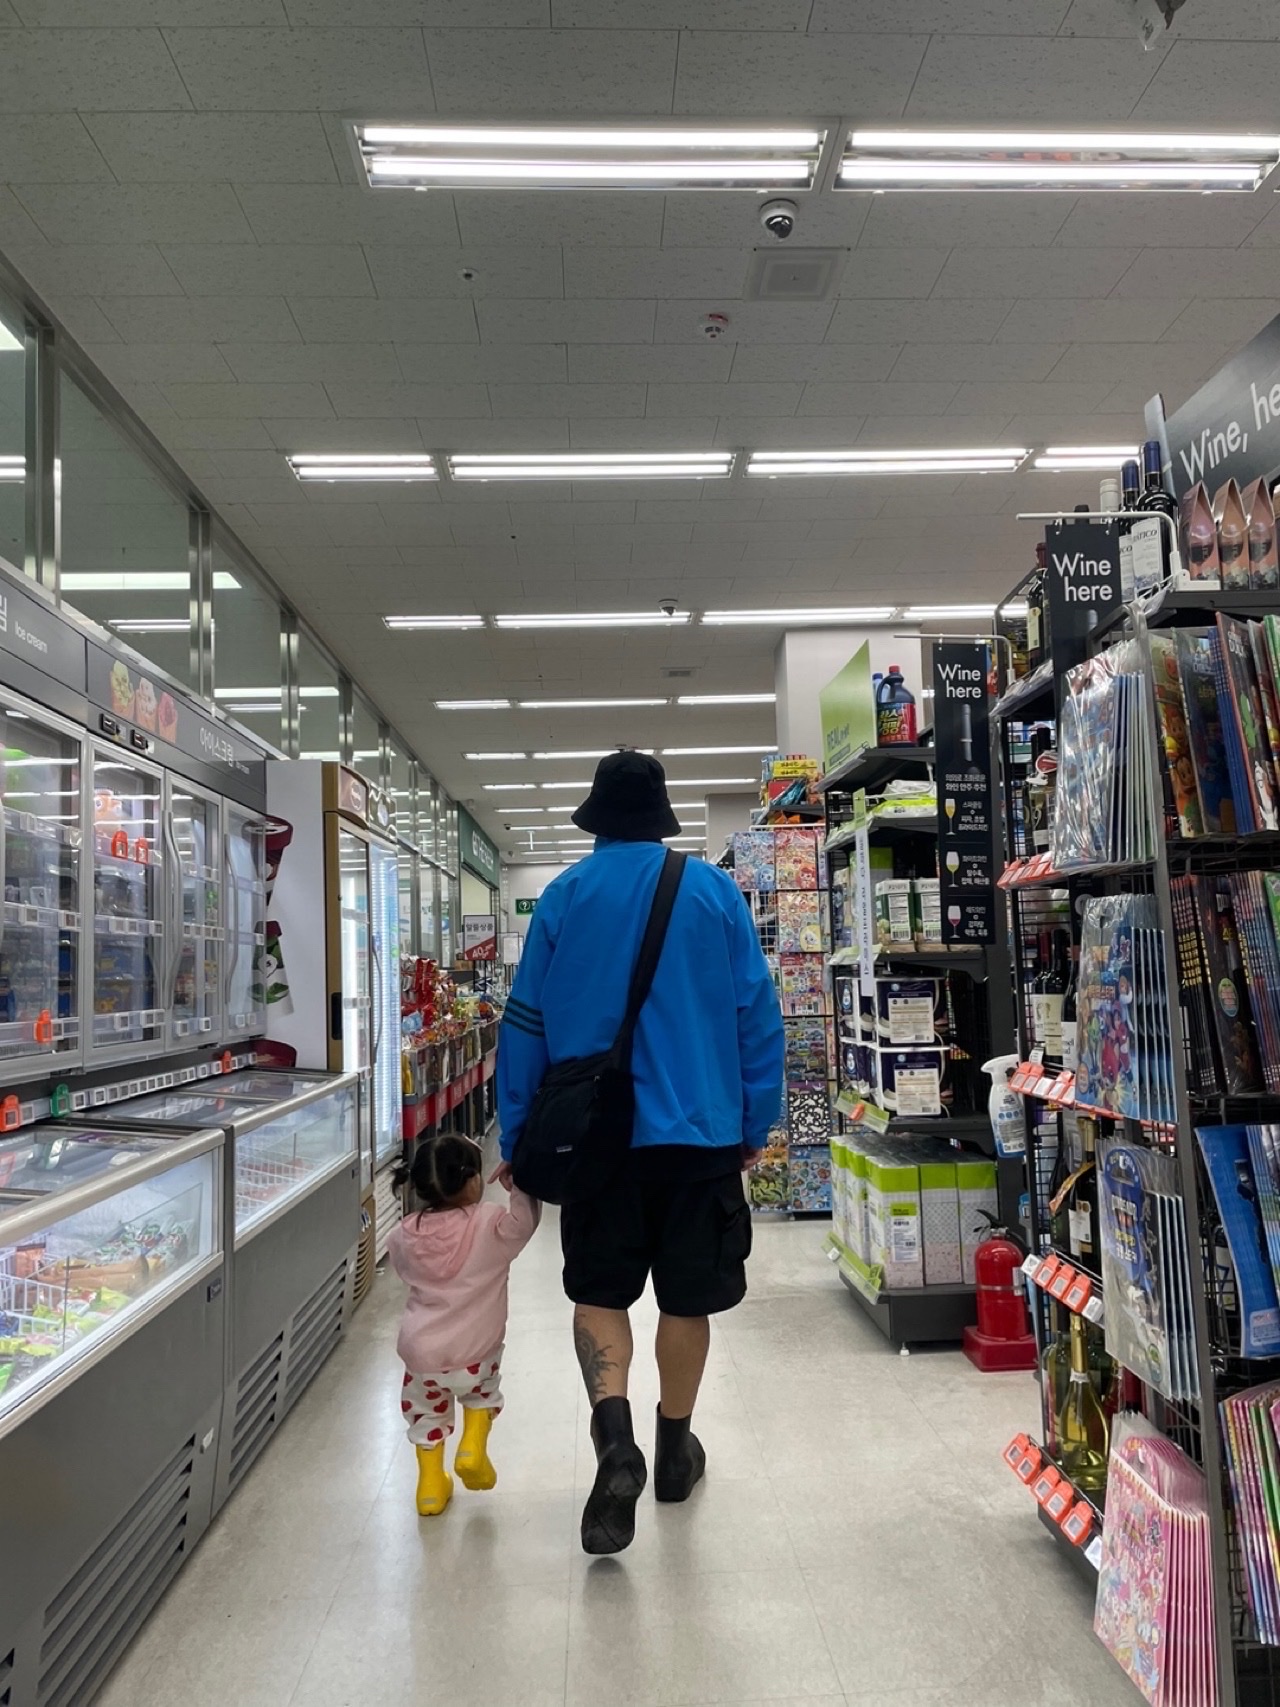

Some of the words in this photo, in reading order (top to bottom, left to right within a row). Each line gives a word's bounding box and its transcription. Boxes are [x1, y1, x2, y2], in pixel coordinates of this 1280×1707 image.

[1179, 421, 1248, 485] Wine,
[1052, 553, 1111, 577] Wine
[1064, 576, 1113, 602] here
[937, 663, 981, 681] Wine
[946, 680, 982, 698] here
[200, 727, 233, 767] 아이스크림
